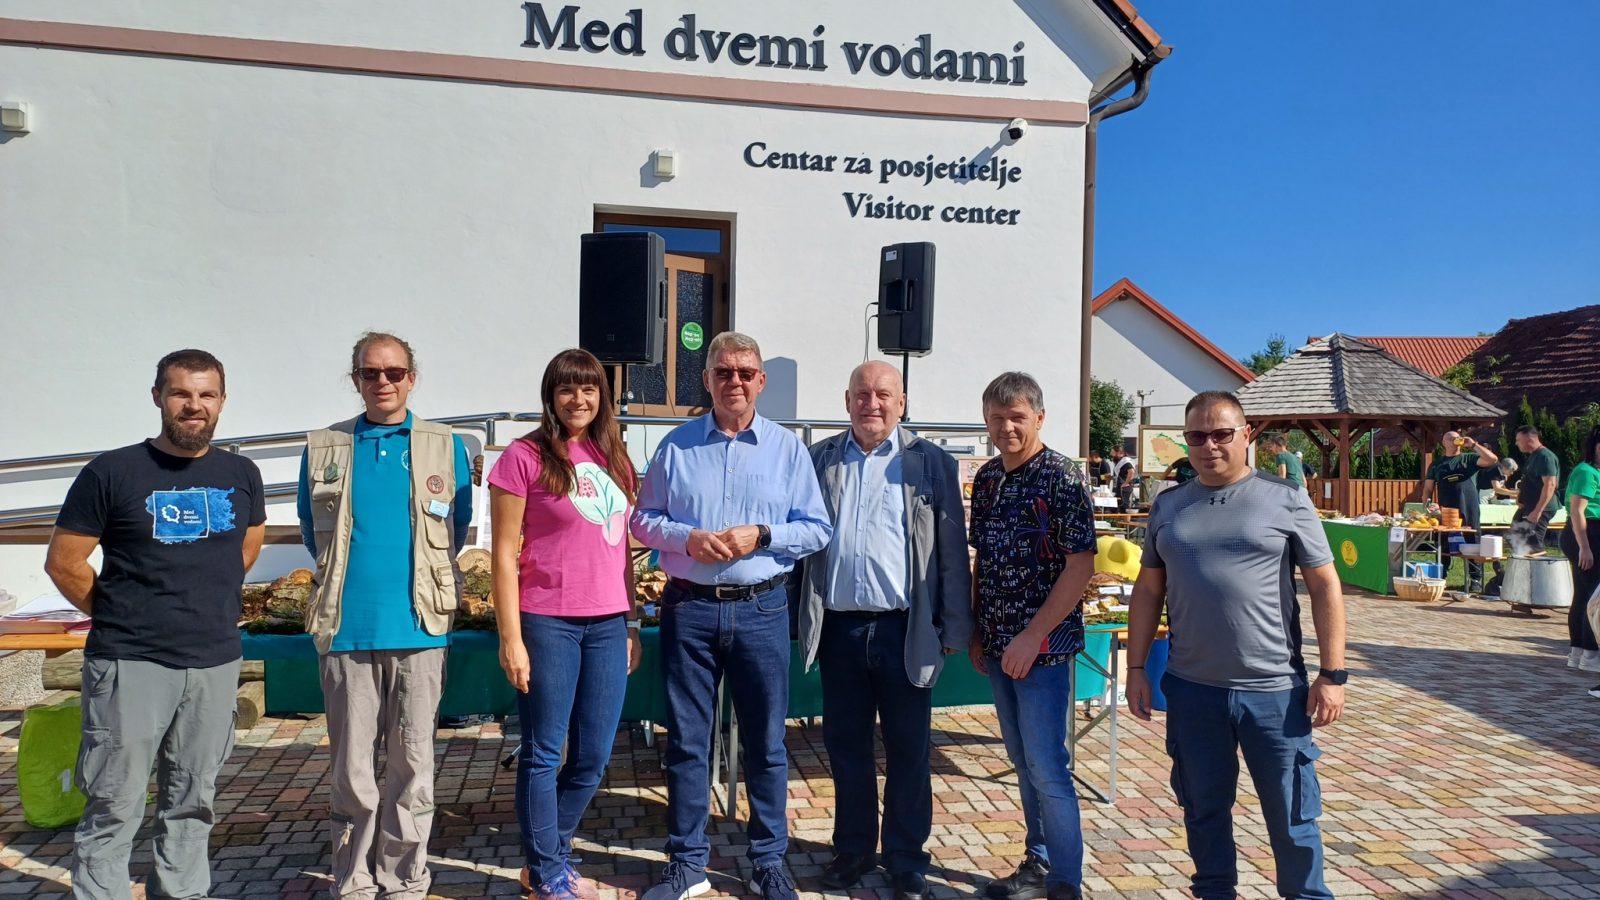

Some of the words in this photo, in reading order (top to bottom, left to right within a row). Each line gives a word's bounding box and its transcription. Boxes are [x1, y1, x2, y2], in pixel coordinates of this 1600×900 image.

[521, 1, 646, 55] Med
[664, 14, 828, 71] dvemi
[841, 34, 1028, 86] vodami
[743, 142, 837, 173] Centar
[844, 156, 873, 176] za
[878, 155, 1022, 189] posjetitelje
[842, 192, 934, 221] Visitor
[941, 204, 1021, 226] center
